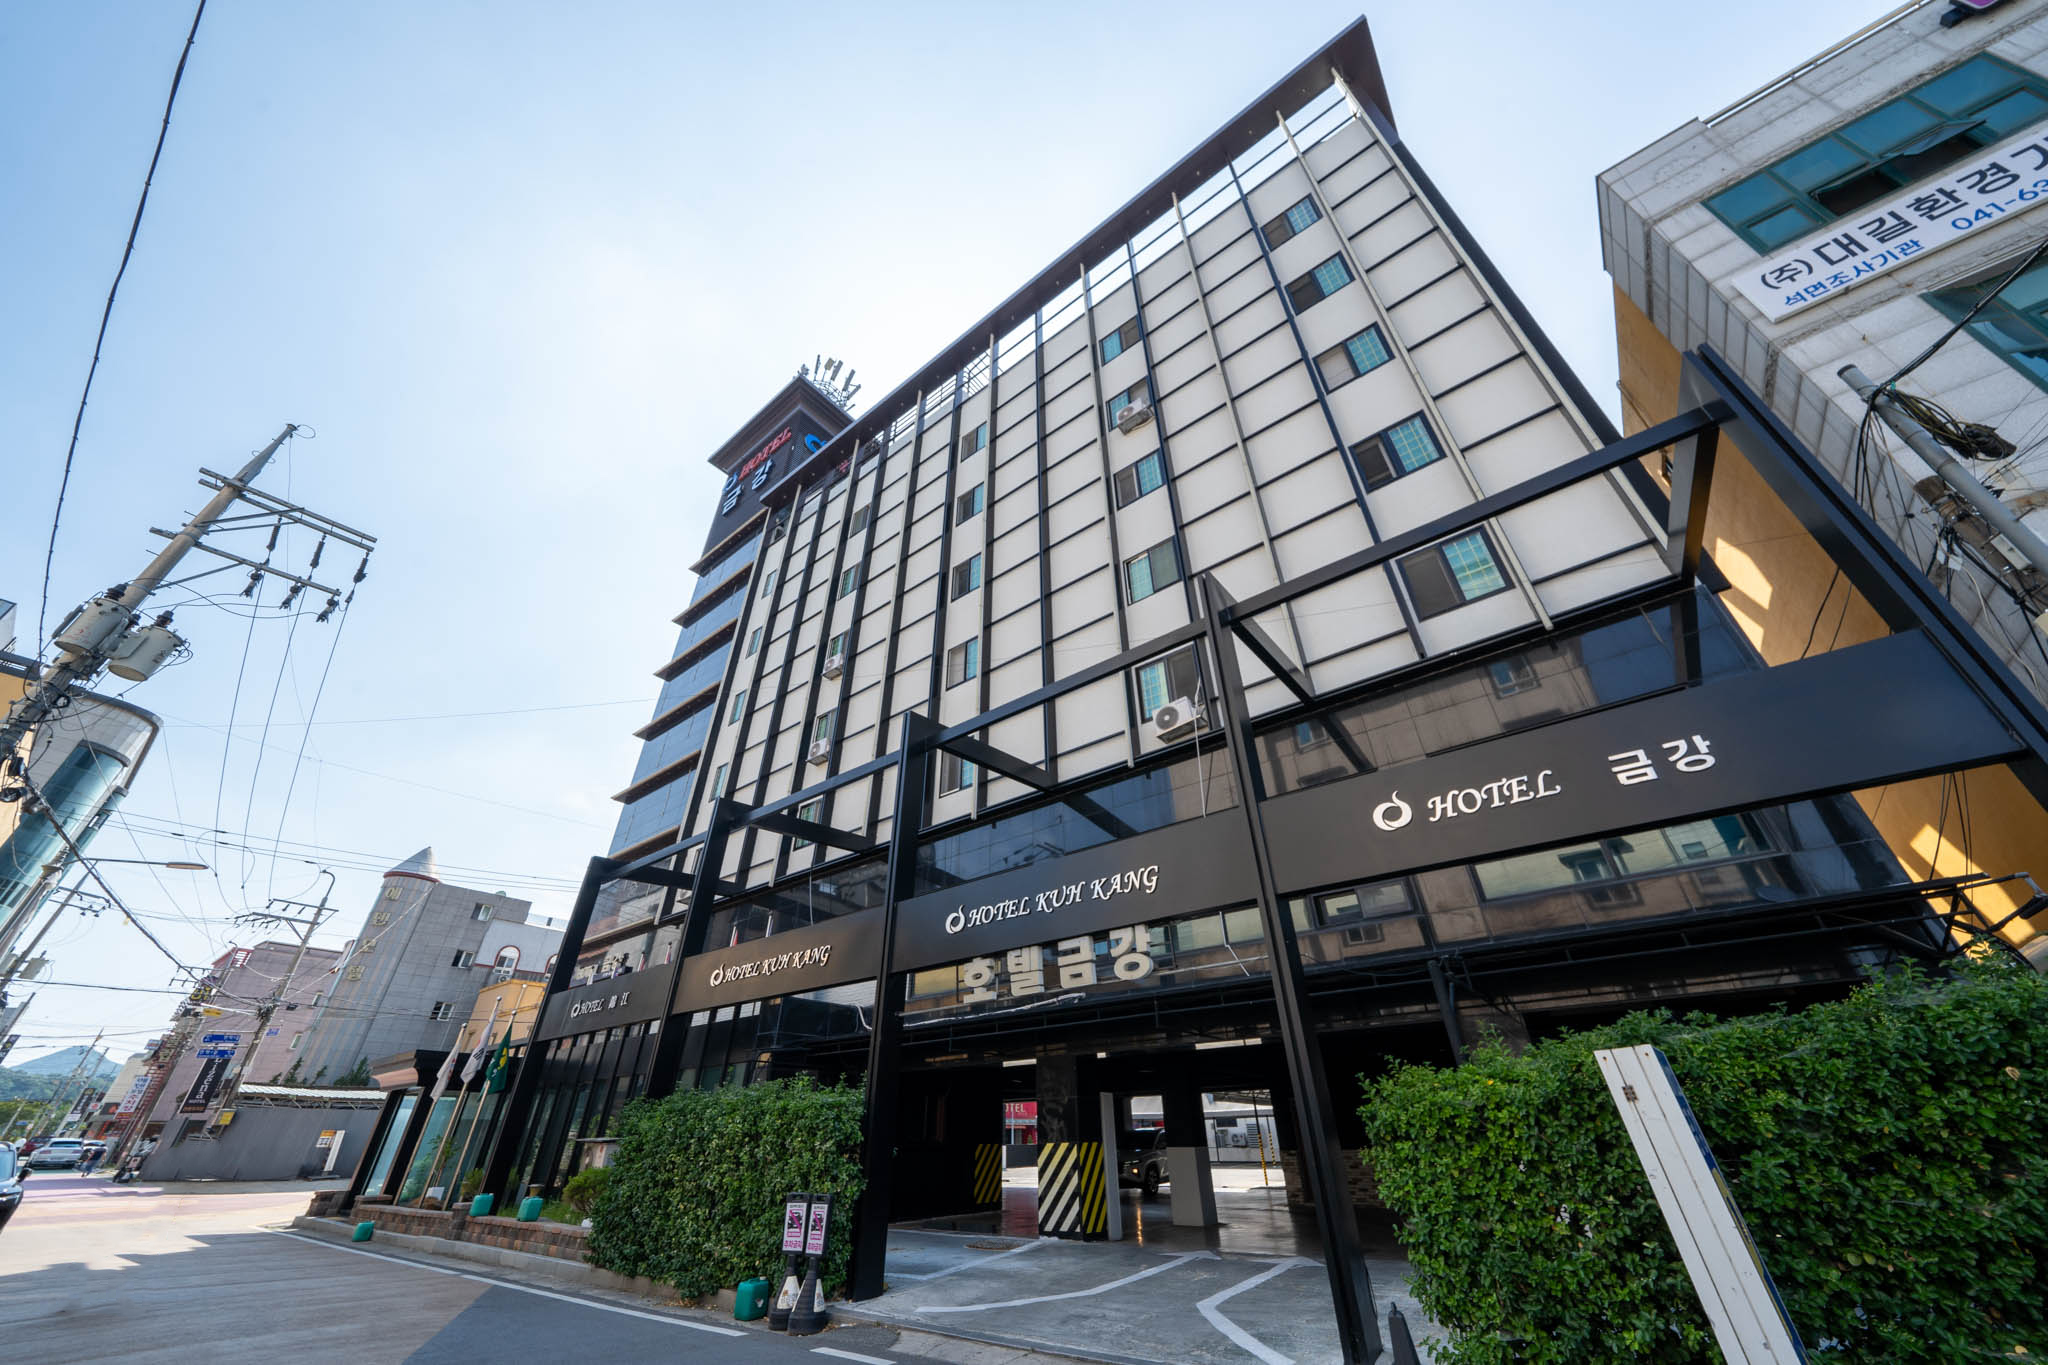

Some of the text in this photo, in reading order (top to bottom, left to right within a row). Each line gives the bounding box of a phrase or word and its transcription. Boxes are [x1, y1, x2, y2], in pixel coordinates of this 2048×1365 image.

[1784, 239, 1925, 307] 석면조사기관
[738, 426, 792, 480] HOTEL
[722, 458, 773, 516] 금강
[1427, 734, 1716, 822] HOTEL 금강
[967, 865, 1160, 928] HOTEL KUH KANG
[723, 945, 831, 983] HOTEL KUH KANG
[579, 998, 605, 1015] HOTEL
